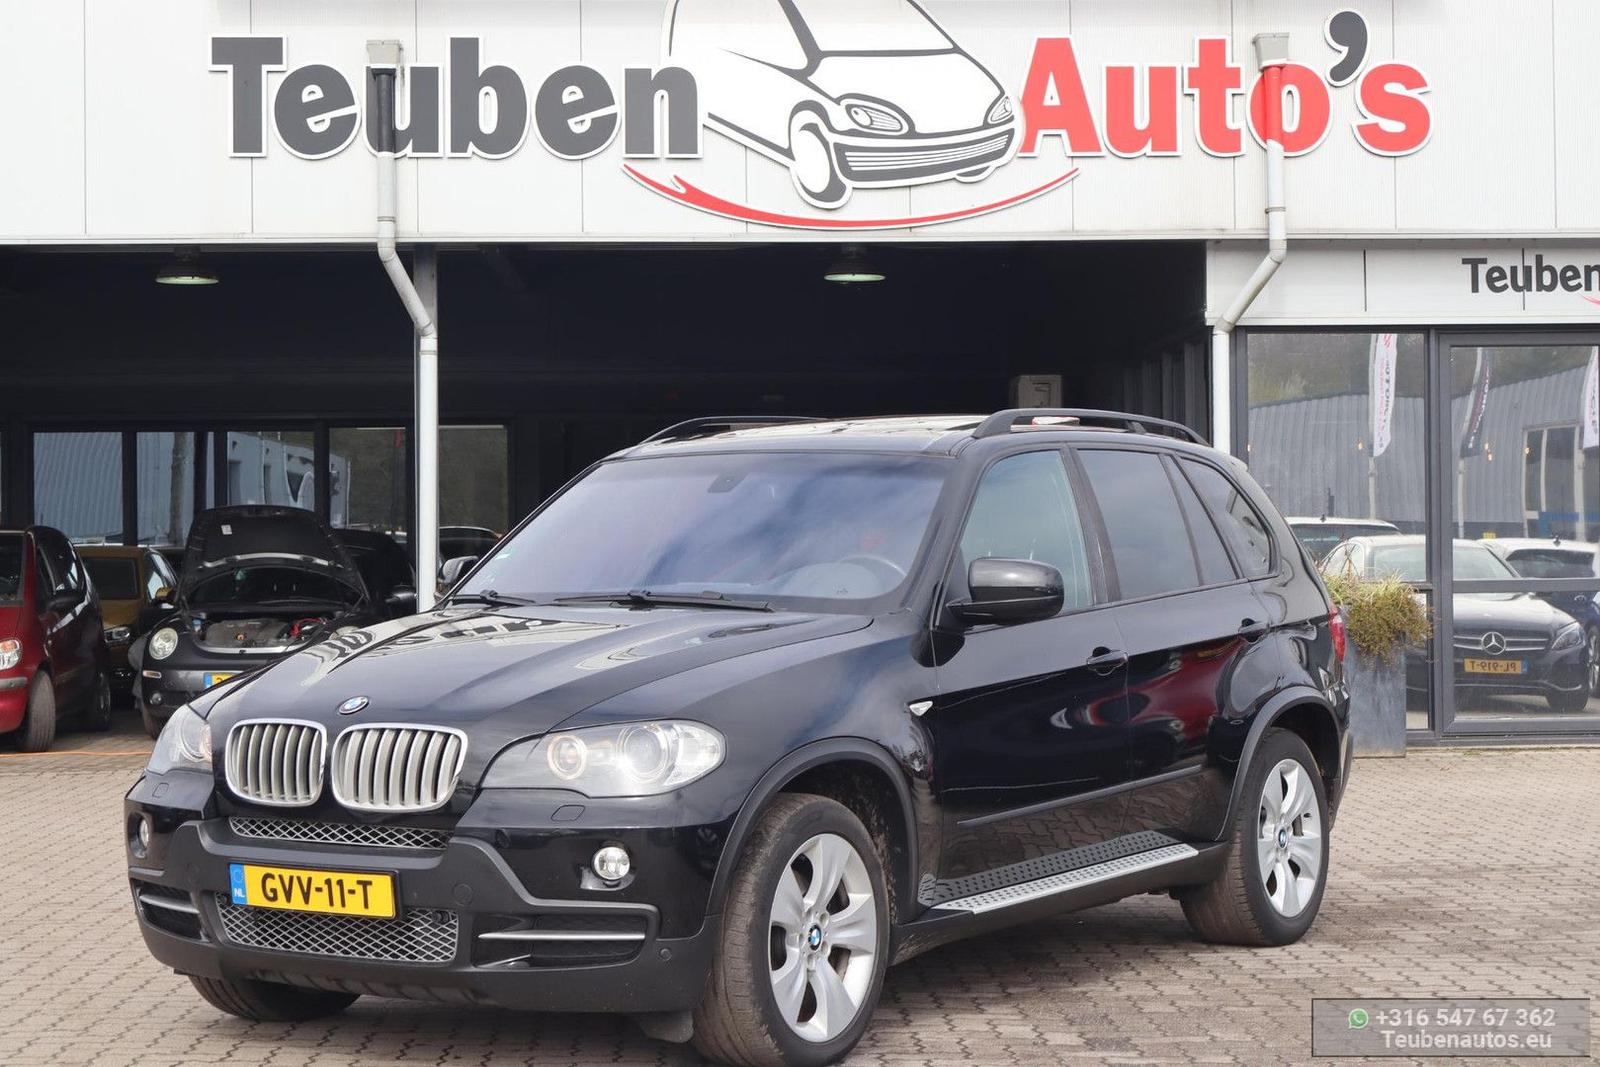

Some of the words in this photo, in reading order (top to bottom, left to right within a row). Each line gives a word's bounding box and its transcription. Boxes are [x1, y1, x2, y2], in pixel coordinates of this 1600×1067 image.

[211, 36, 698, 156] Teuben
[1019, 10, 1431, 153] Auto's
[234, 887, 245, 898] NL
[260, 872, 373, 910] GVV-11-T
